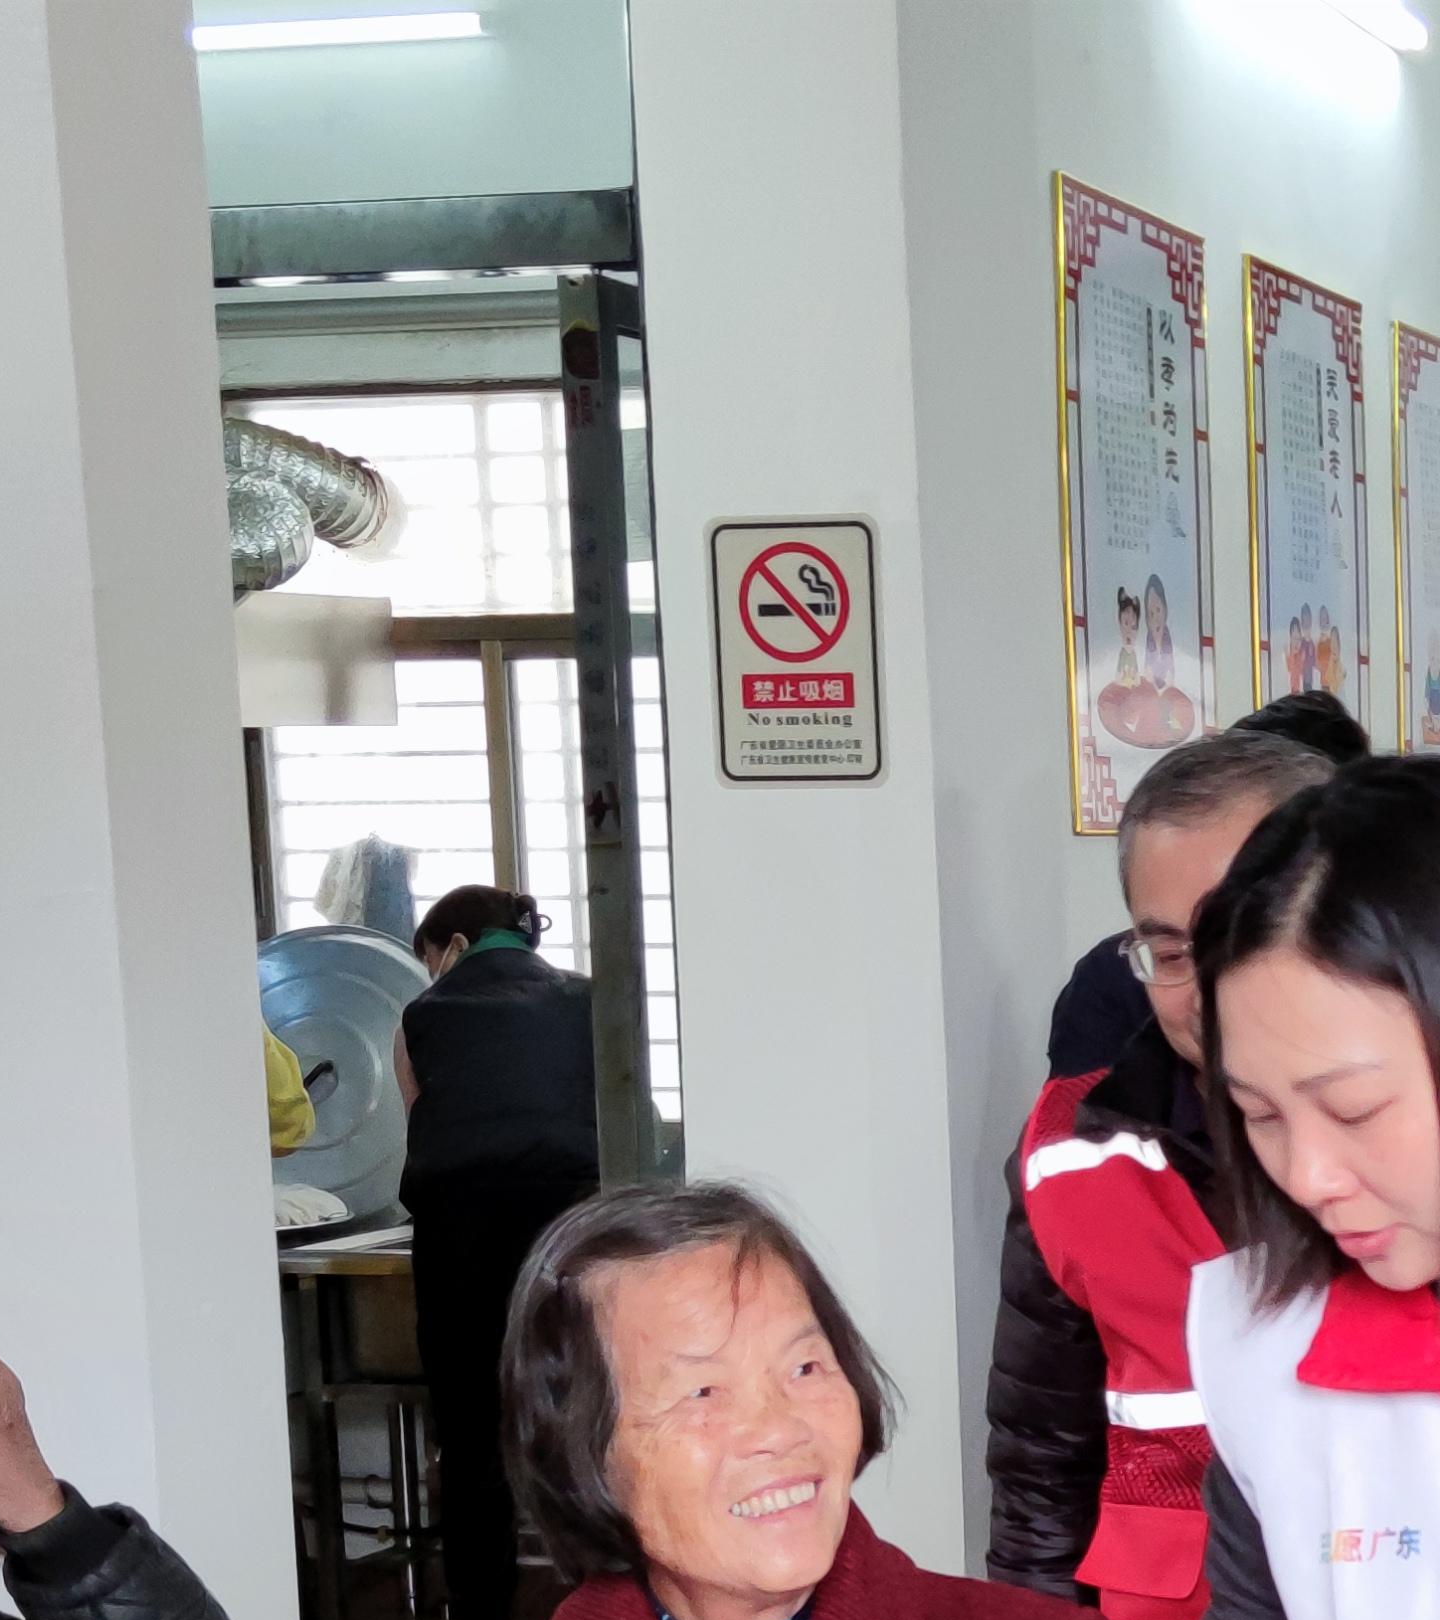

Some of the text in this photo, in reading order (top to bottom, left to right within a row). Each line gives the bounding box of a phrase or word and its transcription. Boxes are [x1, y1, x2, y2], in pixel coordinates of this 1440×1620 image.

[753, 680, 845, 702] 禁止吸烟
[745, 712, 853, 728] No smoking
